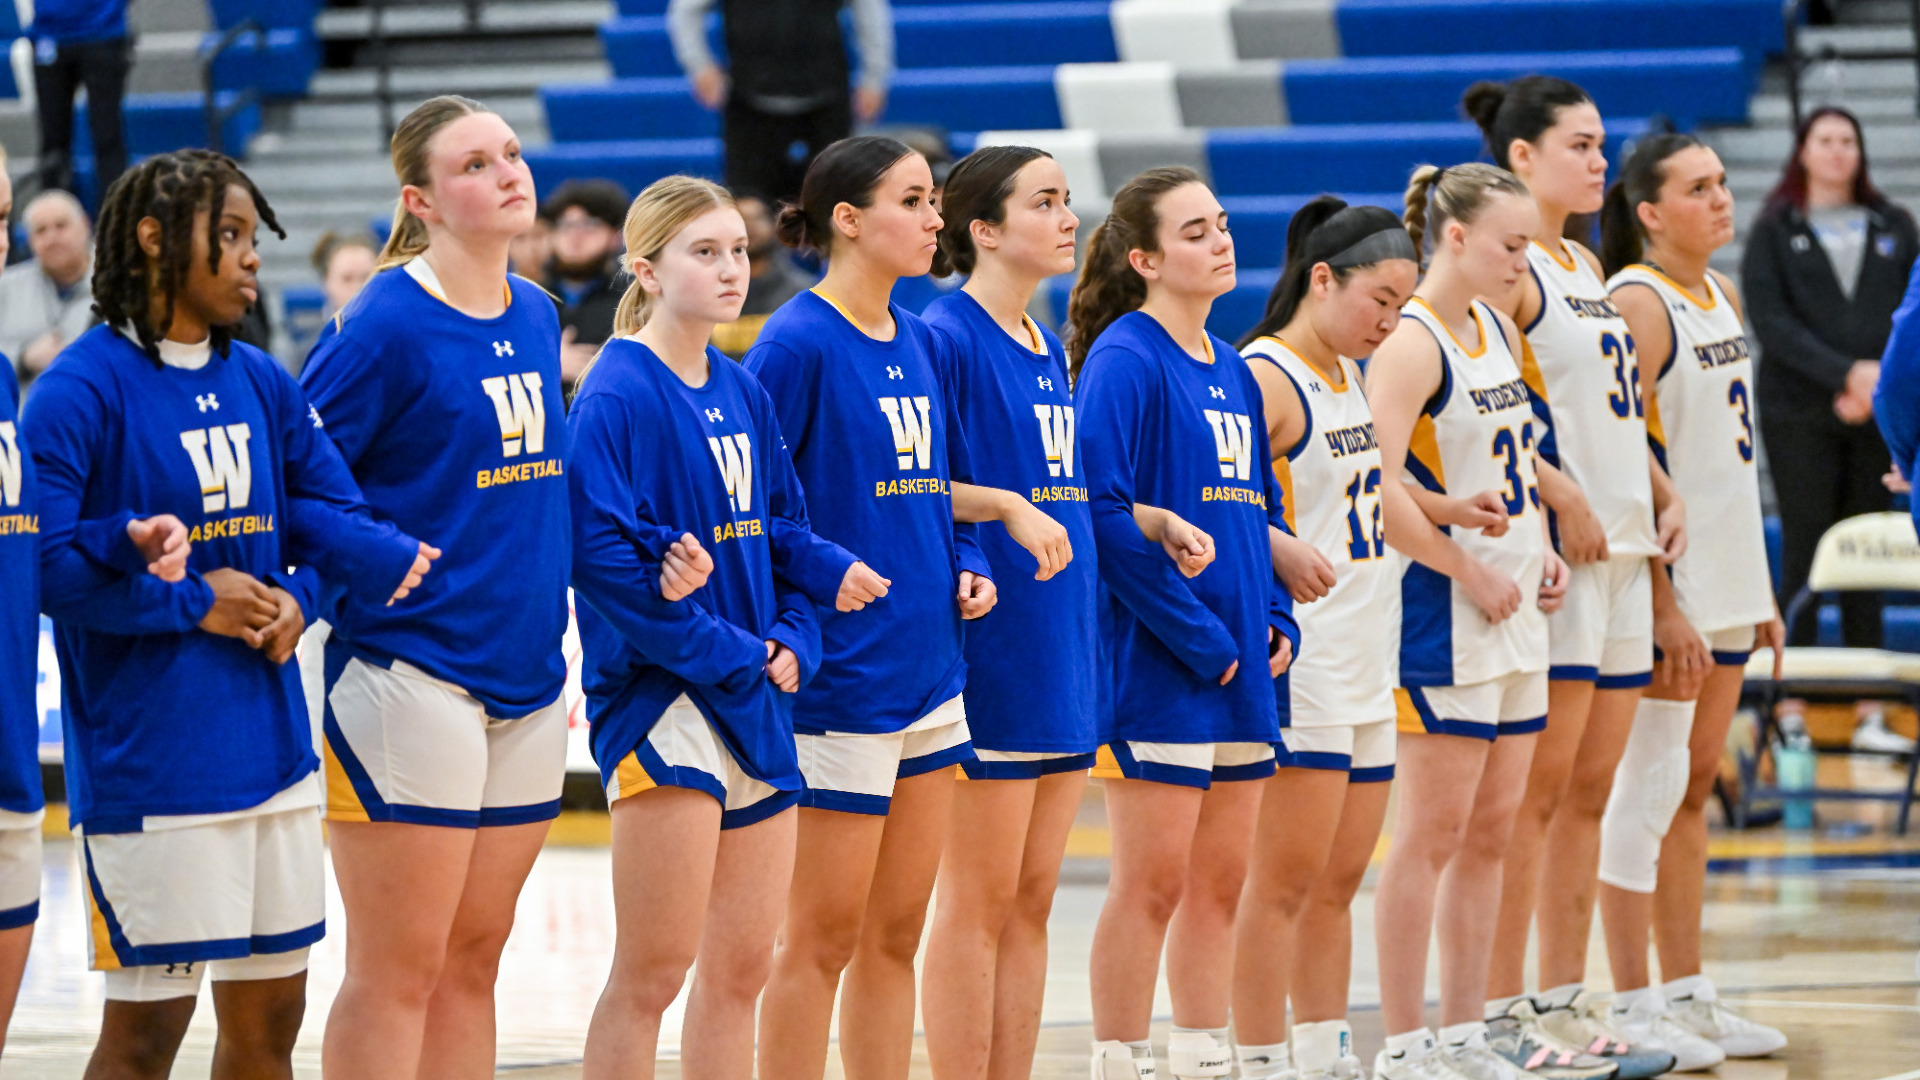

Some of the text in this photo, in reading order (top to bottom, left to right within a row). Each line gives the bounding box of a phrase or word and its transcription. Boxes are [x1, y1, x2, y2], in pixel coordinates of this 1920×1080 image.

[481, 371, 545, 458] W
[878, 396, 931, 470] W
[1033, 404, 1075, 478] W
[1203, 409, 1252, 481] W
[179, 422, 251, 514] W
[707, 432, 752, 512] W
[1345, 465, 1384, 562] 12
